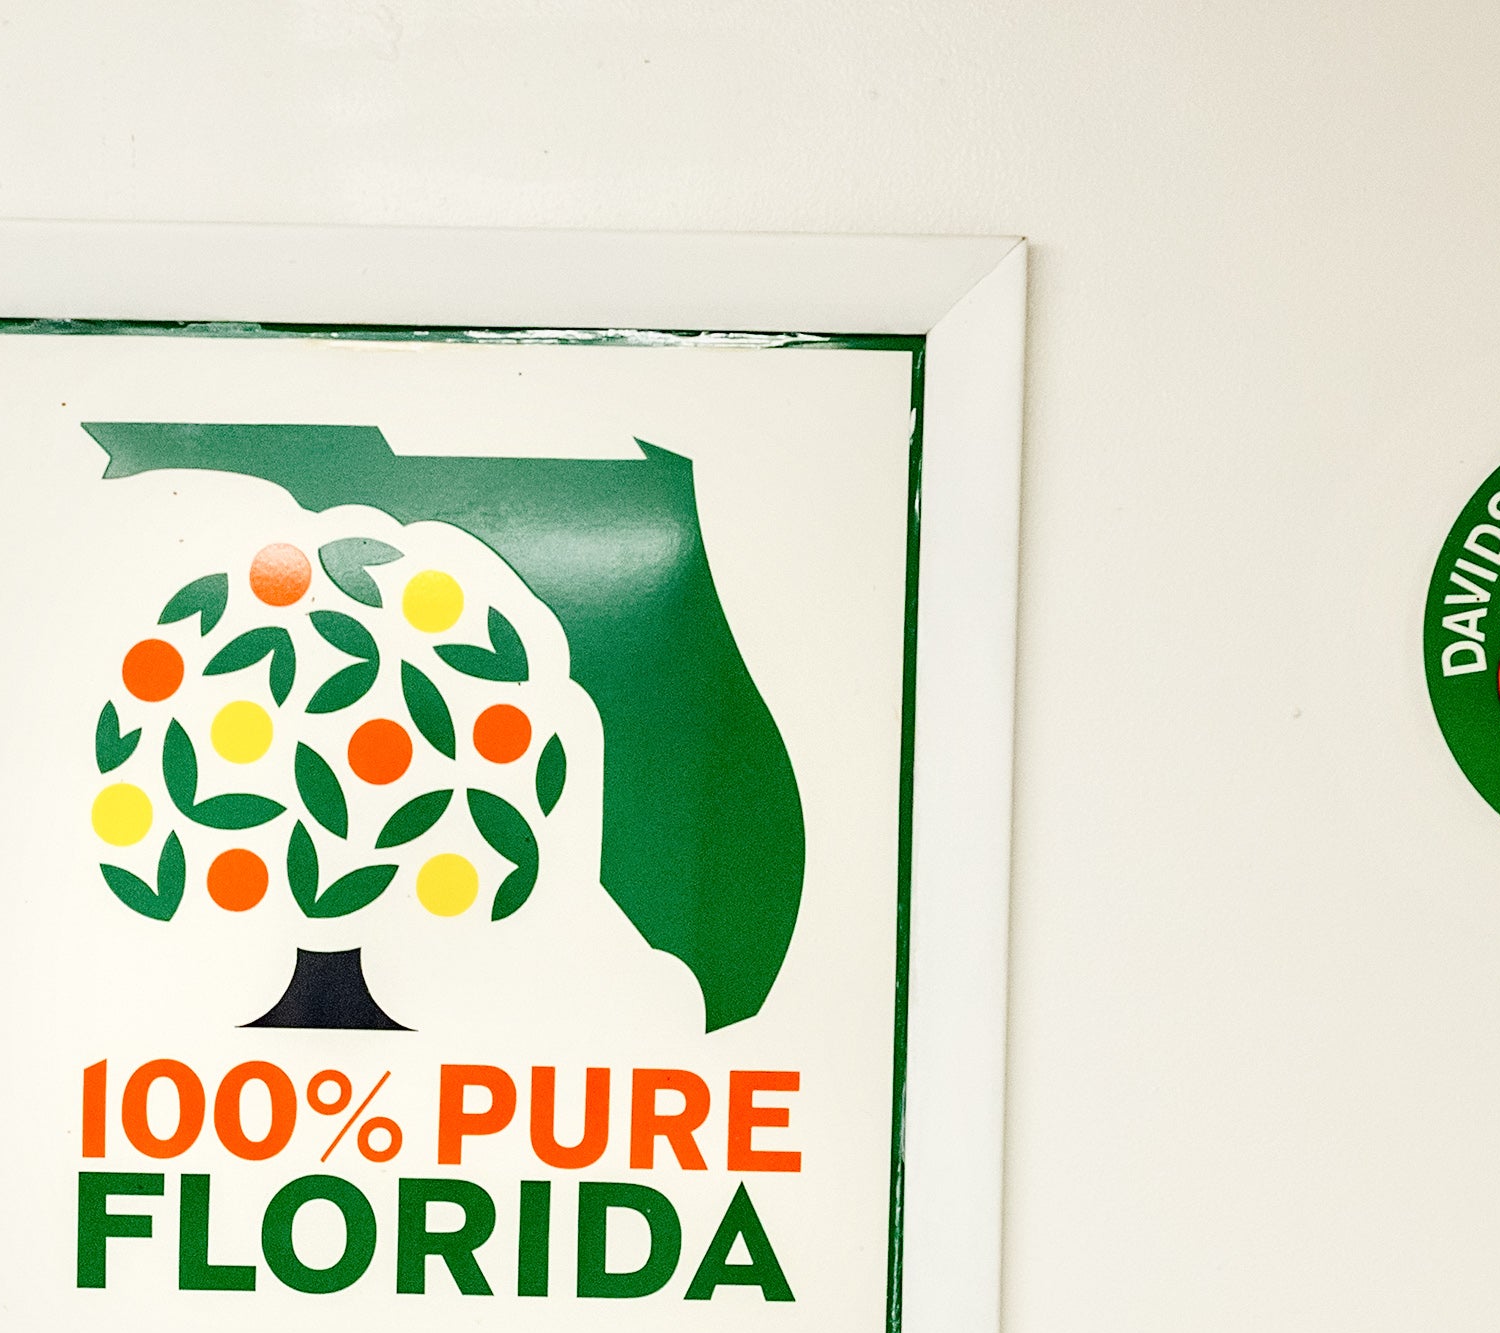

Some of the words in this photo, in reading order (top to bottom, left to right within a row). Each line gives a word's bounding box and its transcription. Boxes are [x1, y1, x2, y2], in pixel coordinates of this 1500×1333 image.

[81, 1058, 405, 1163] 100%
[438, 1063, 802, 1173] PURE
[76, 1171, 796, 1303] FLORIDA
